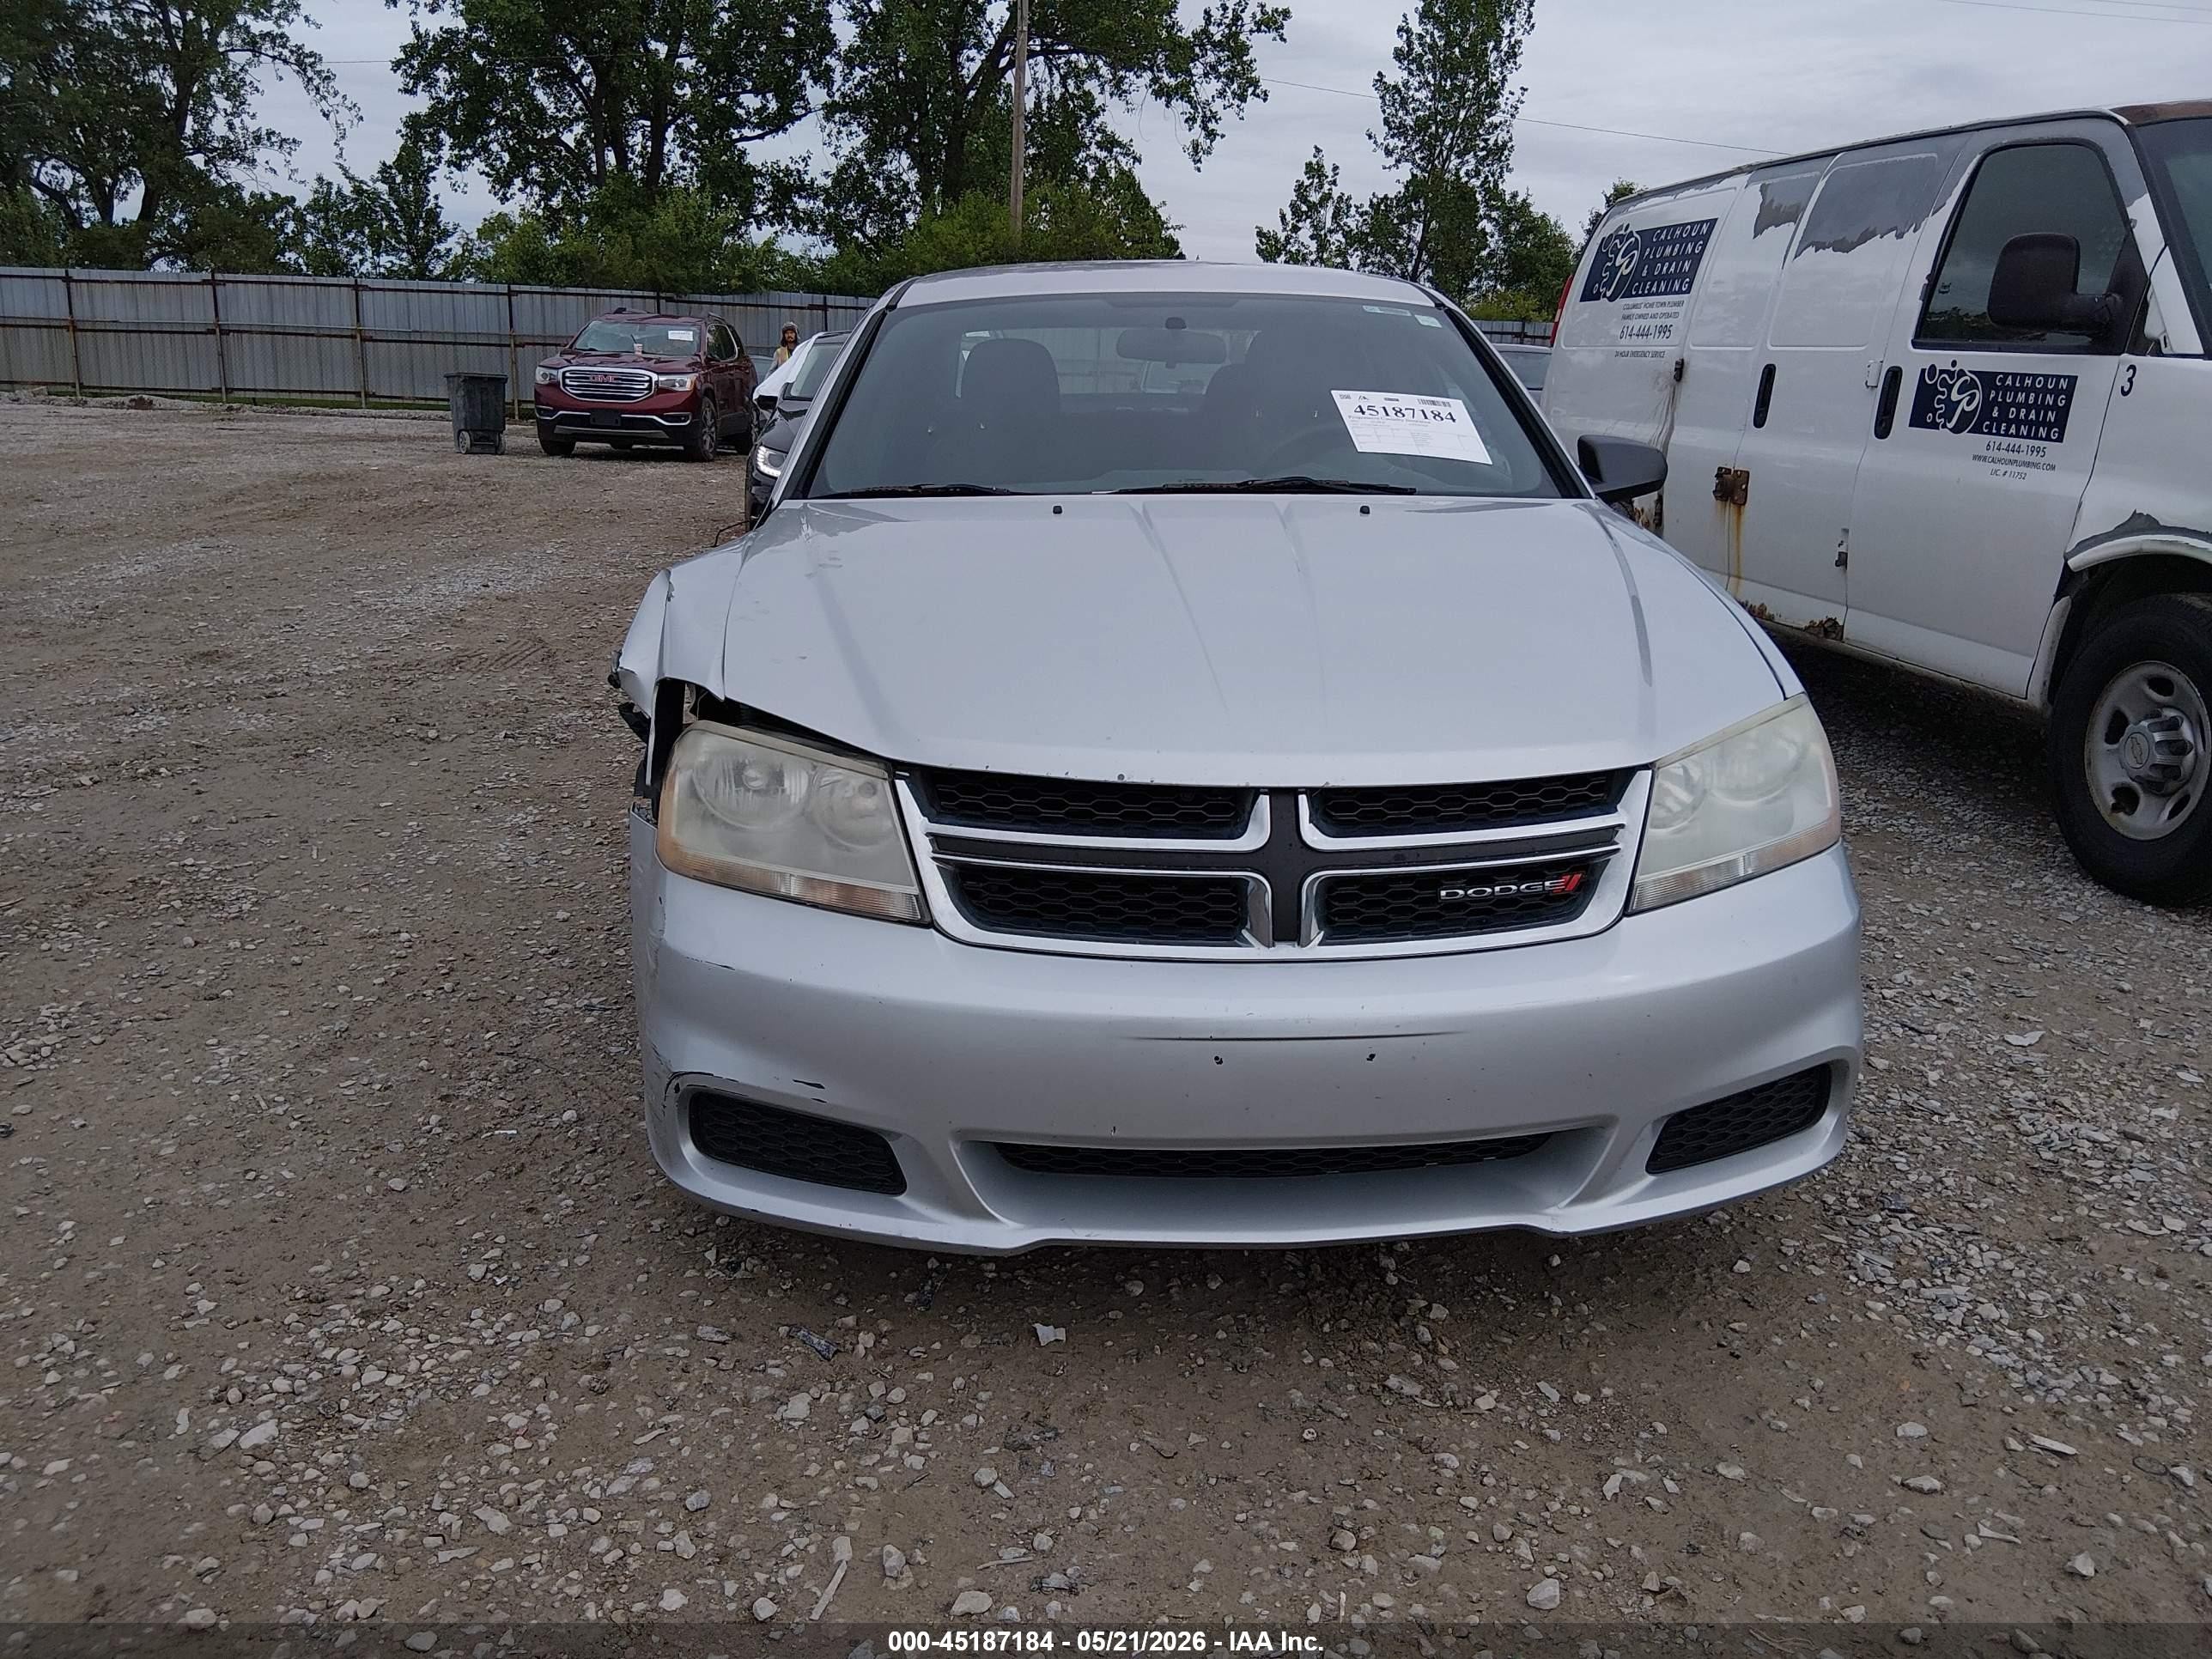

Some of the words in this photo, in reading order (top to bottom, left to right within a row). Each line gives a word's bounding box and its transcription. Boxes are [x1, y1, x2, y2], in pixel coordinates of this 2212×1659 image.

[1653, 222, 1710, 241] CALHOUN
[1643, 240, 1703, 259] PLUMBING
[1642, 264, 1648, 276] &
[1654, 259, 1692, 275] DRAIN
[1632, 278, 1690, 295] CLEANING
[1620, 324, 1674, 340] 614-444-1995
[590, 374, 619, 383] GMC
[1996, 374, 2069, 390] CALHOUN
[2120, 364, 2136, 397] 3
[1989, 390, 2066, 407] PLUMBING
[1353, 404, 1457, 423] 45187184
[1992, 406, 1999, 417] &
[2008, 407, 2057, 422] DRAIN
[1982, 421, 2059, 440] CLEANING
[1985, 441, 2047, 458] 614-444-1995
[1972, 453, 2057, 471] WWW.CALHOUNPLUMBING.COM
[2008, 471, 2027, 480] 11752
[1440, 878, 1566, 900] DODGE
